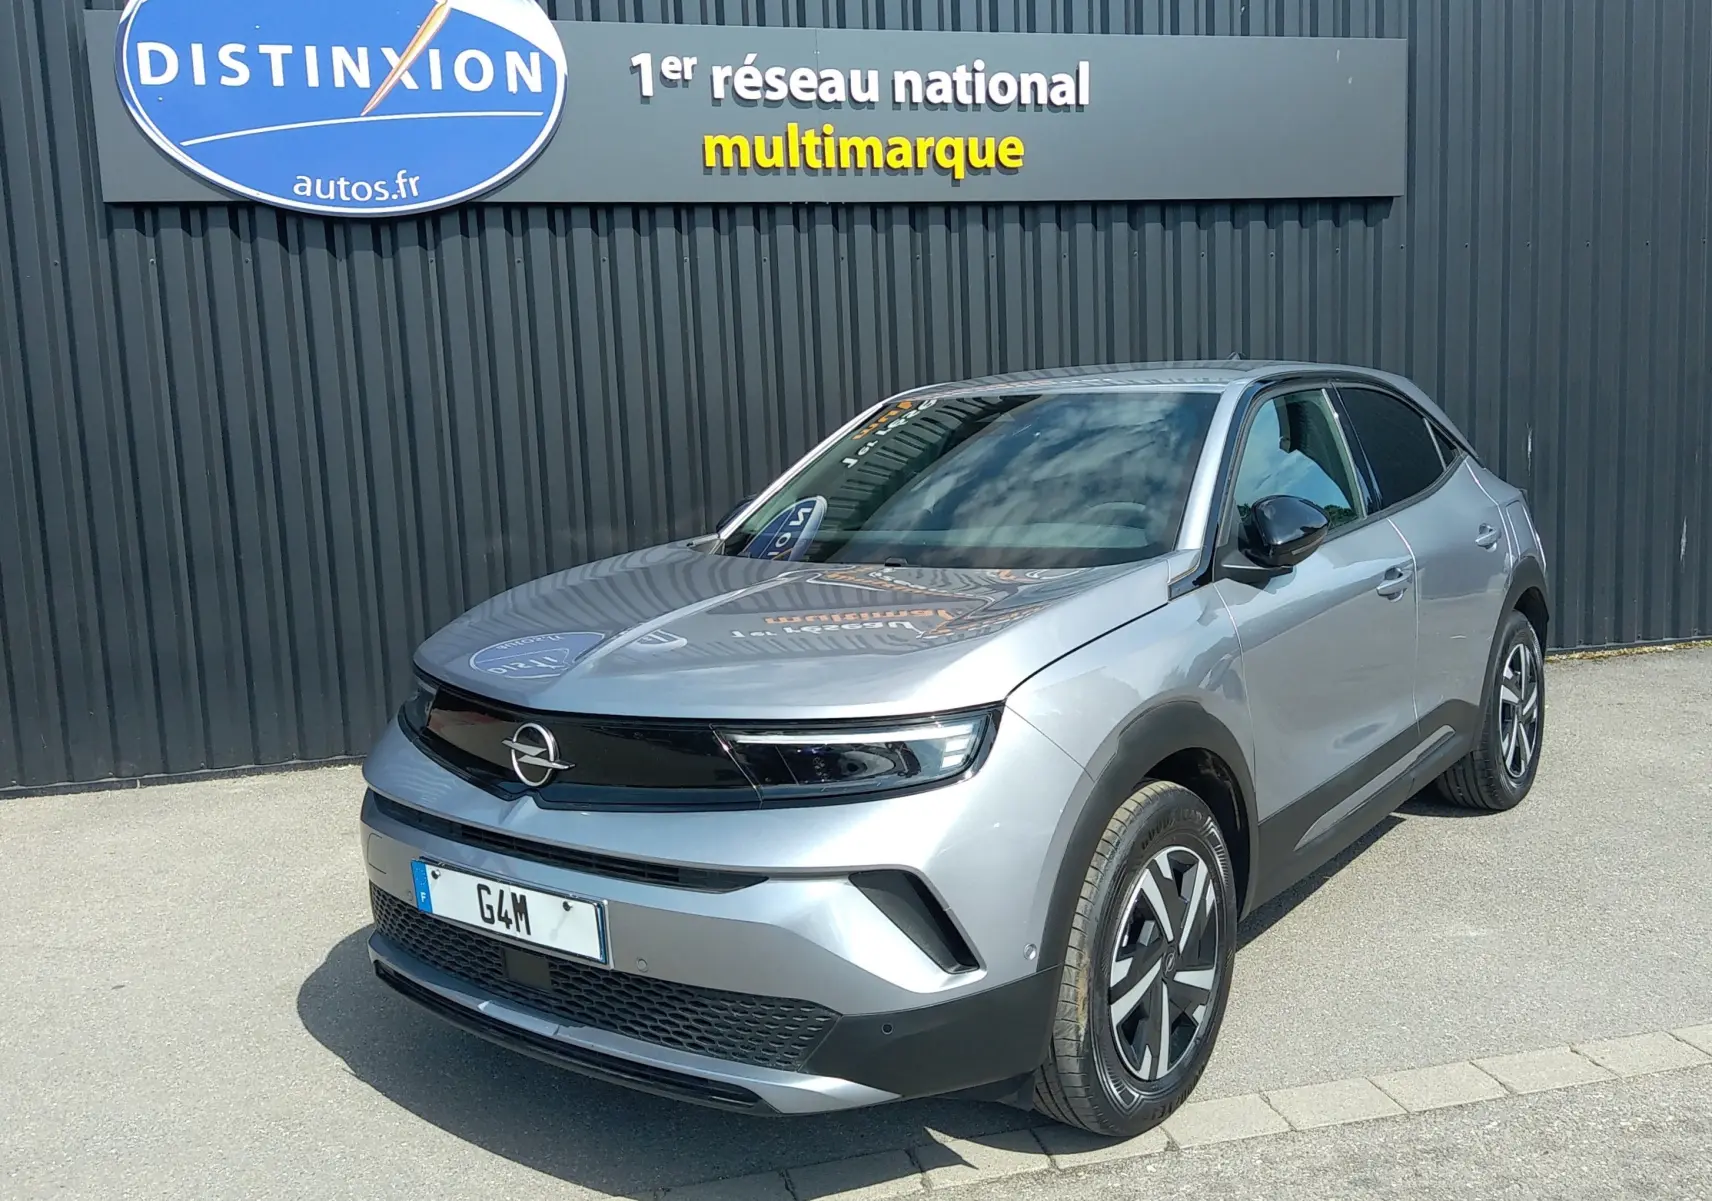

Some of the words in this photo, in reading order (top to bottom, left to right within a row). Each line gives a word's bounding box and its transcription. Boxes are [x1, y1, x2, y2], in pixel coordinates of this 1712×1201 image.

[136, 40, 543, 95] DISTINXION
[630, 52, 698, 98] 1er
[711, 52, 880, 103] réseau
[893, 58, 1091, 106] national
[703, 122, 1025, 180] multimarque
[292, 169, 420, 202] autos.fr
[476, 883, 532, 936] G4M
